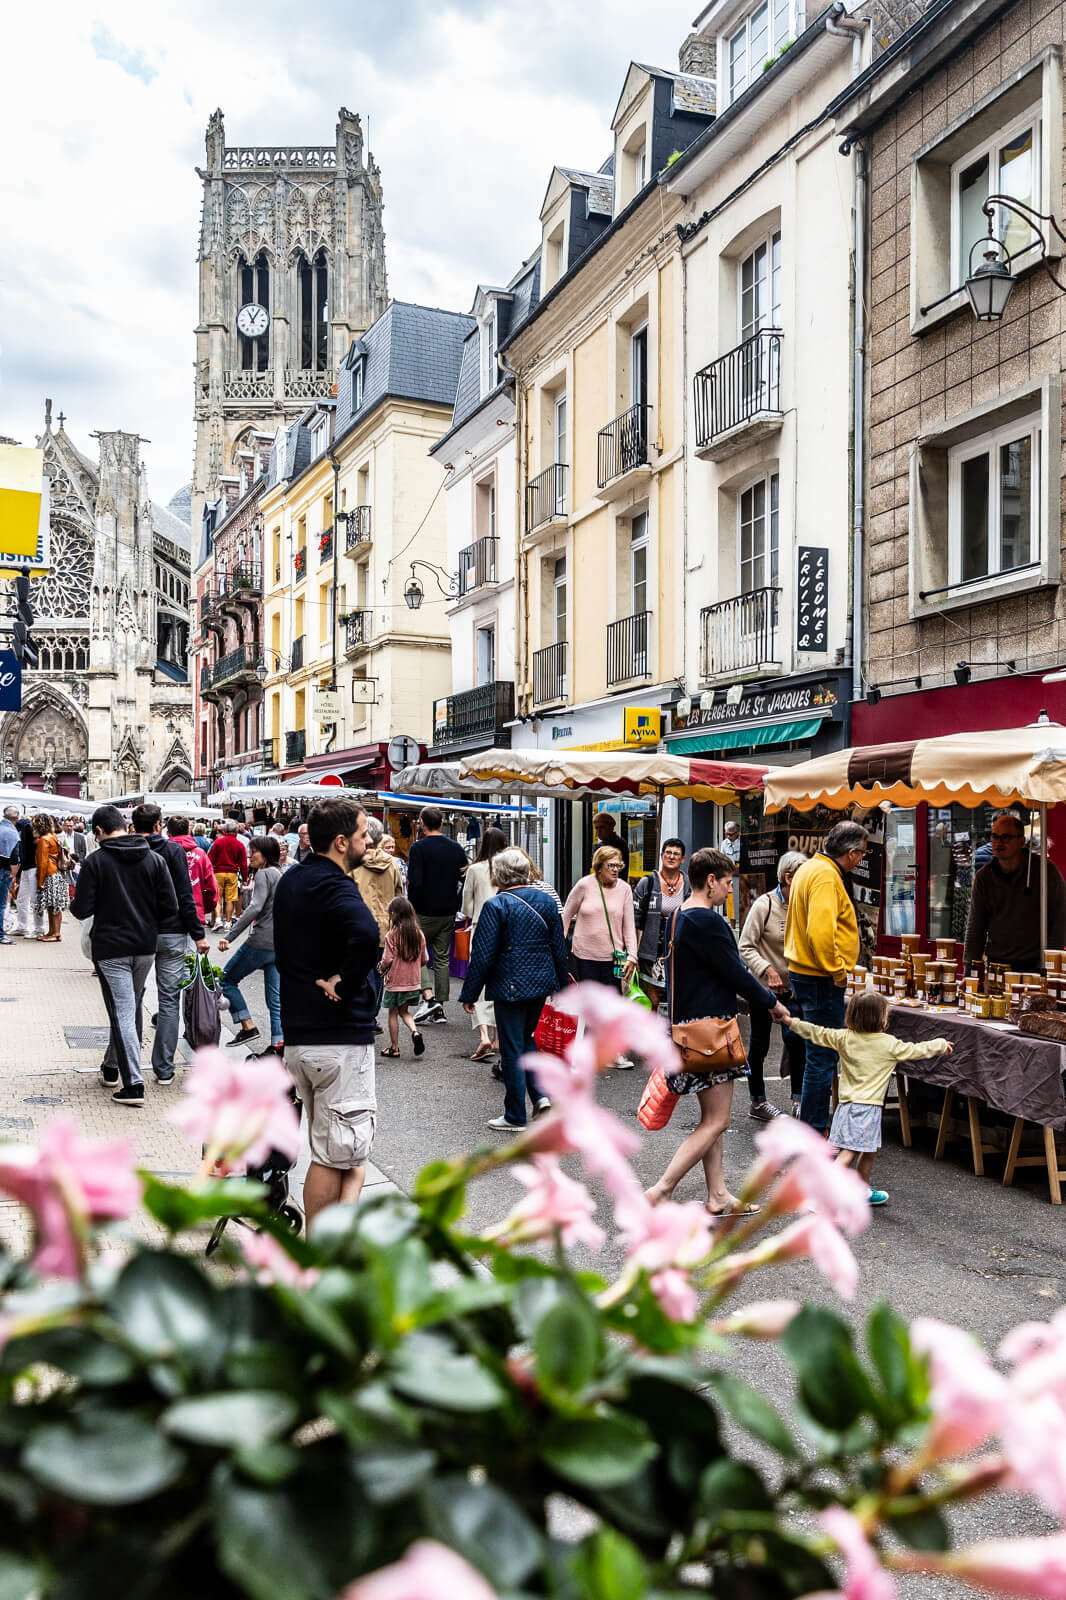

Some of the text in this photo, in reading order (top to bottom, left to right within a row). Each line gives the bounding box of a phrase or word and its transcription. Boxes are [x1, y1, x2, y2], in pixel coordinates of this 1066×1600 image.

[798, 551, 811, 647] FRUITS &
[812, 556, 827, 644] LEGUMES
[630, 728, 657, 738] AVIVA
[686, 709, 700, 728] LES
[701, 701, 737, 724] VERGERS
[738, 699, 751, 716] DE
[767, 688, 812, 714] JACQUES
